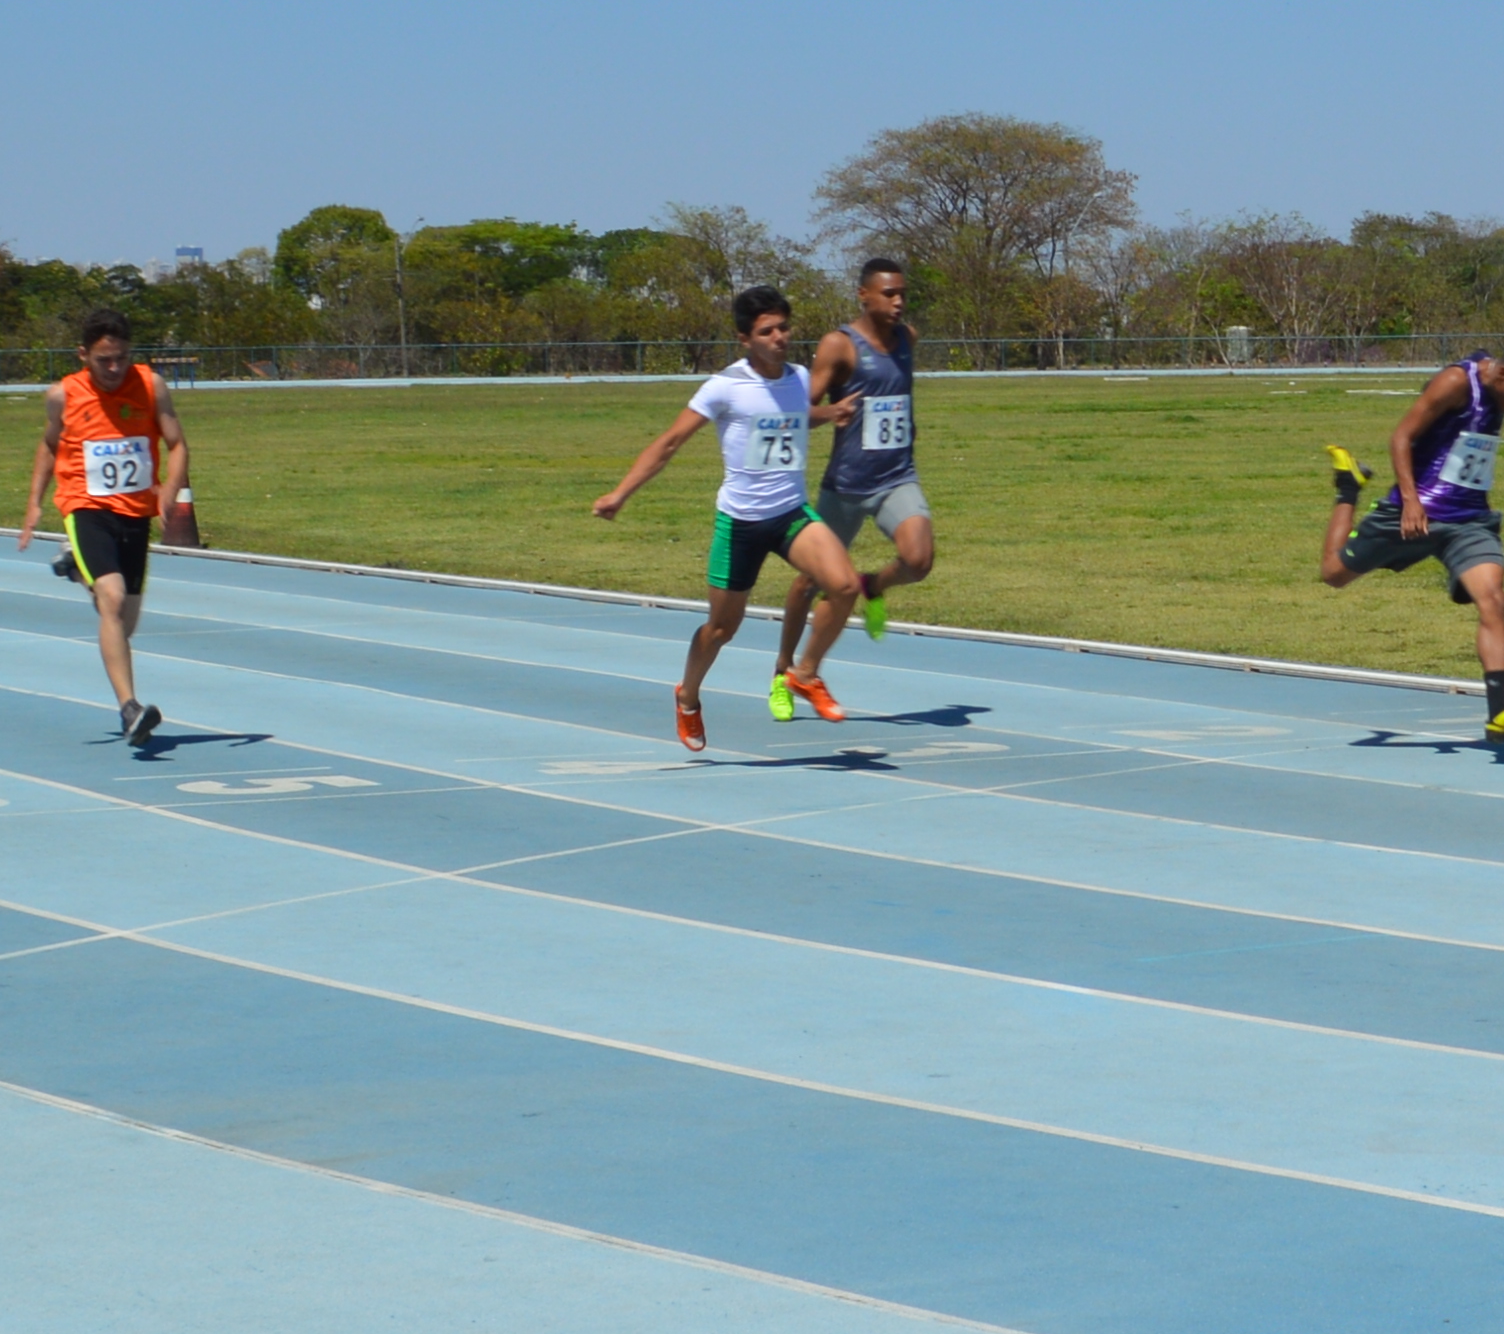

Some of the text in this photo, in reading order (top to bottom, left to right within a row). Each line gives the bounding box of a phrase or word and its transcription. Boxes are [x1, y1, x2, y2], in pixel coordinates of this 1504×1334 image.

[757, 417, 800, 430] CAIXA
[879, 417, 907, 444] 85
[92, 442, 143, 456] CAIXA
[762, 436, 793, 465] 75
[102, 460, 138, 489] 92
